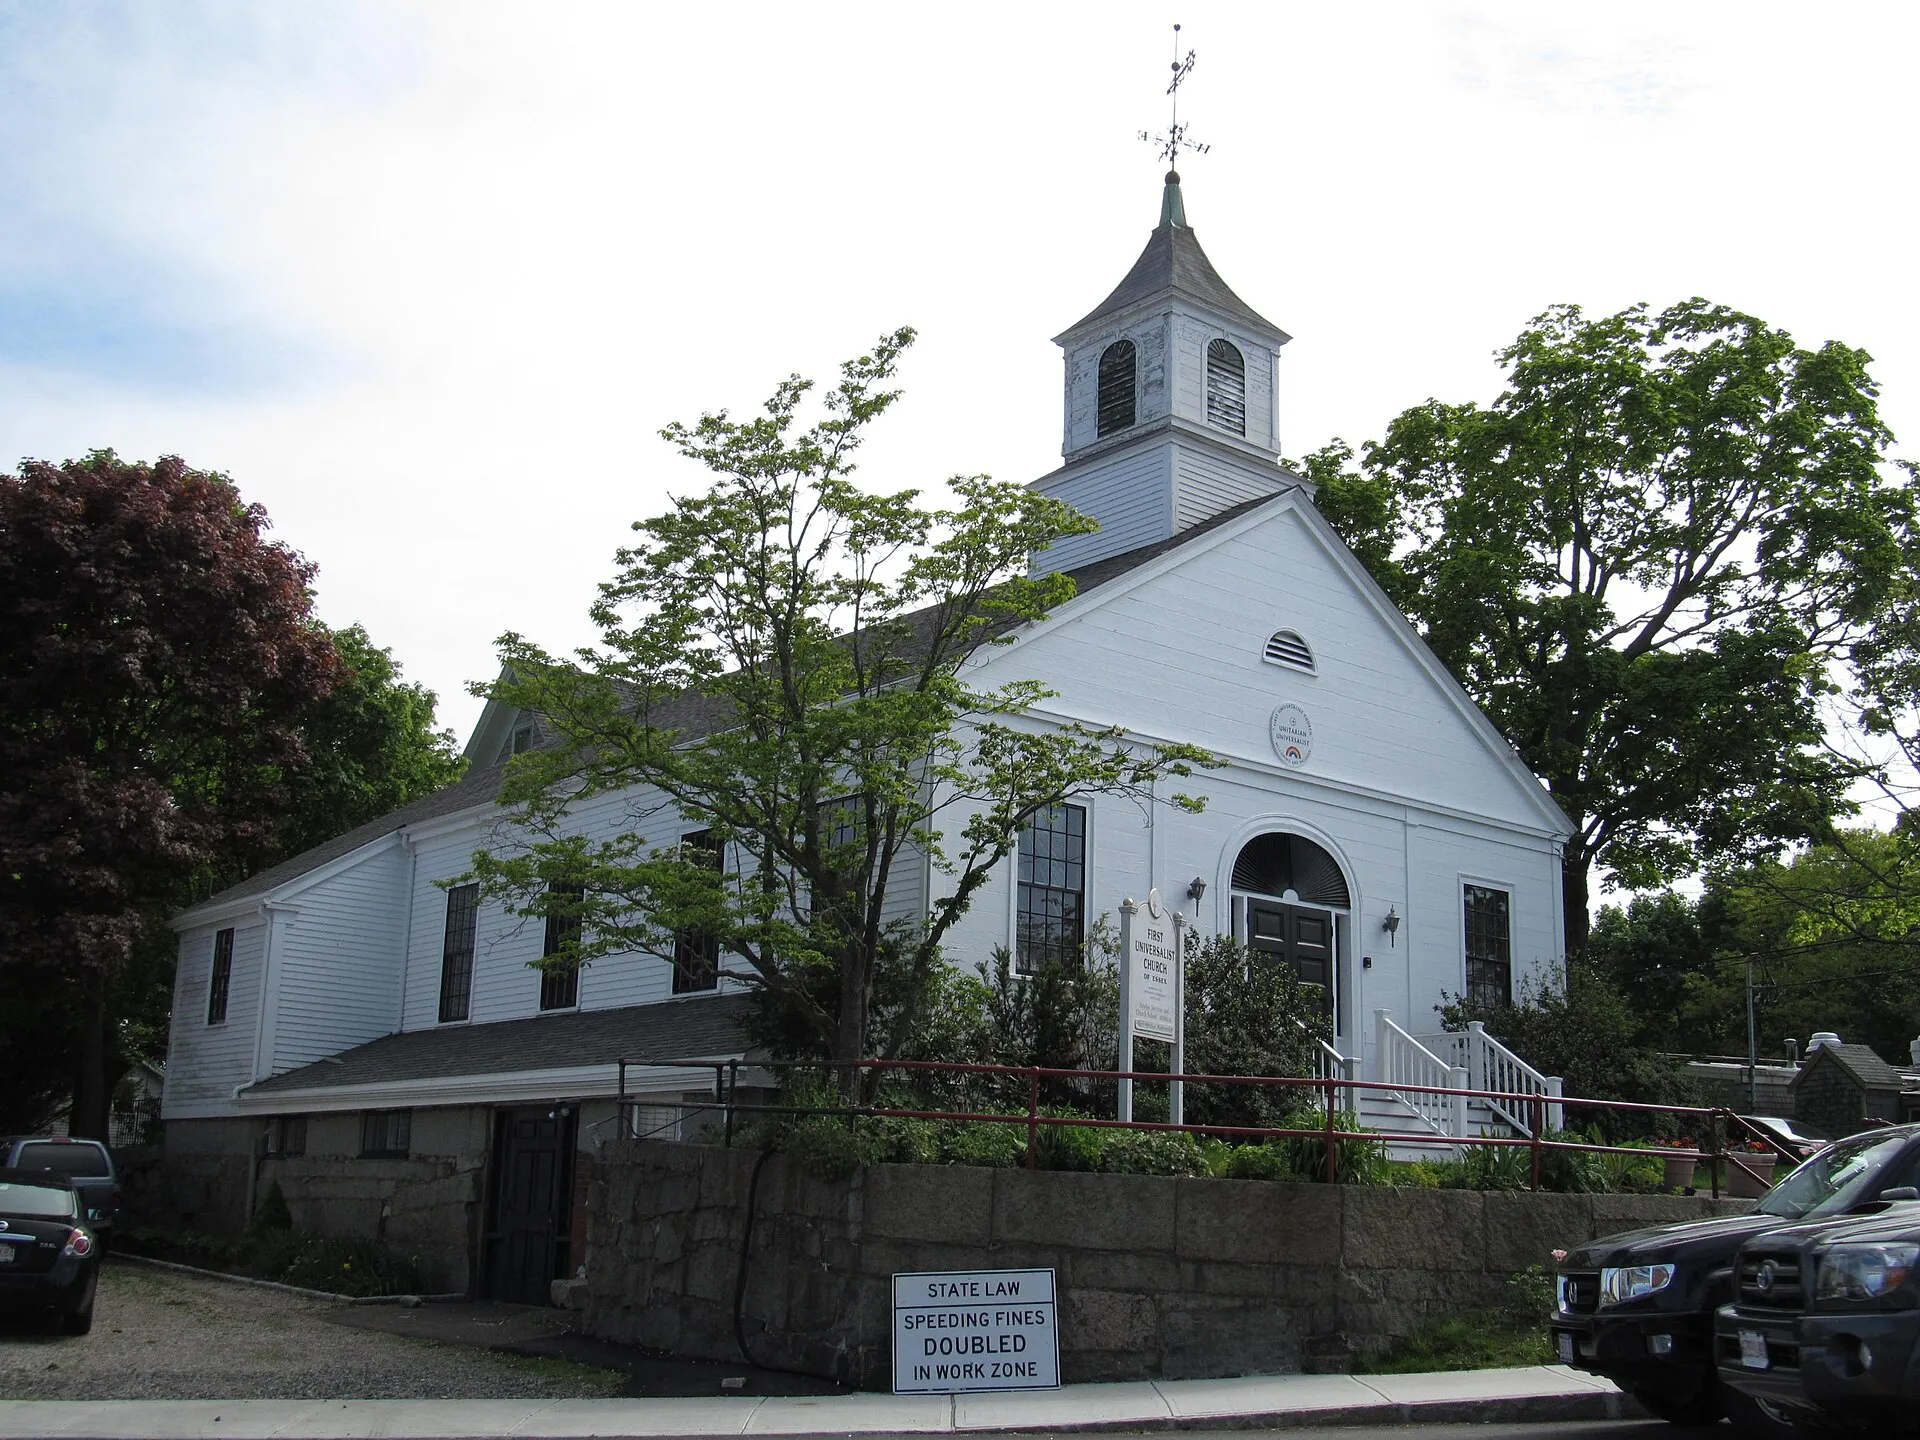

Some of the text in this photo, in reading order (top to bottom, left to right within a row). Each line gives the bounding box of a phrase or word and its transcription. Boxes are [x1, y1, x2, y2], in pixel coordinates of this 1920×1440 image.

[1278, 725, 1307, 737] UNITARIAN
[1147, 928, 1164, 943] FIRST
[1135, 940, 1175, 962] UNIVERSALIST
[1143, 958, 1168, 975] CHURCH
[1152, 975, 1168, 985] ESSEX
[928, 1281, 1020, 1298] STATE LAW
[904, 1310, 1045, 1330] SPEEDING FINES
[924, 1334, 1027, 1356] DOUBLED
[914, 1362, 1038, 1381] IN WORK ZONE
